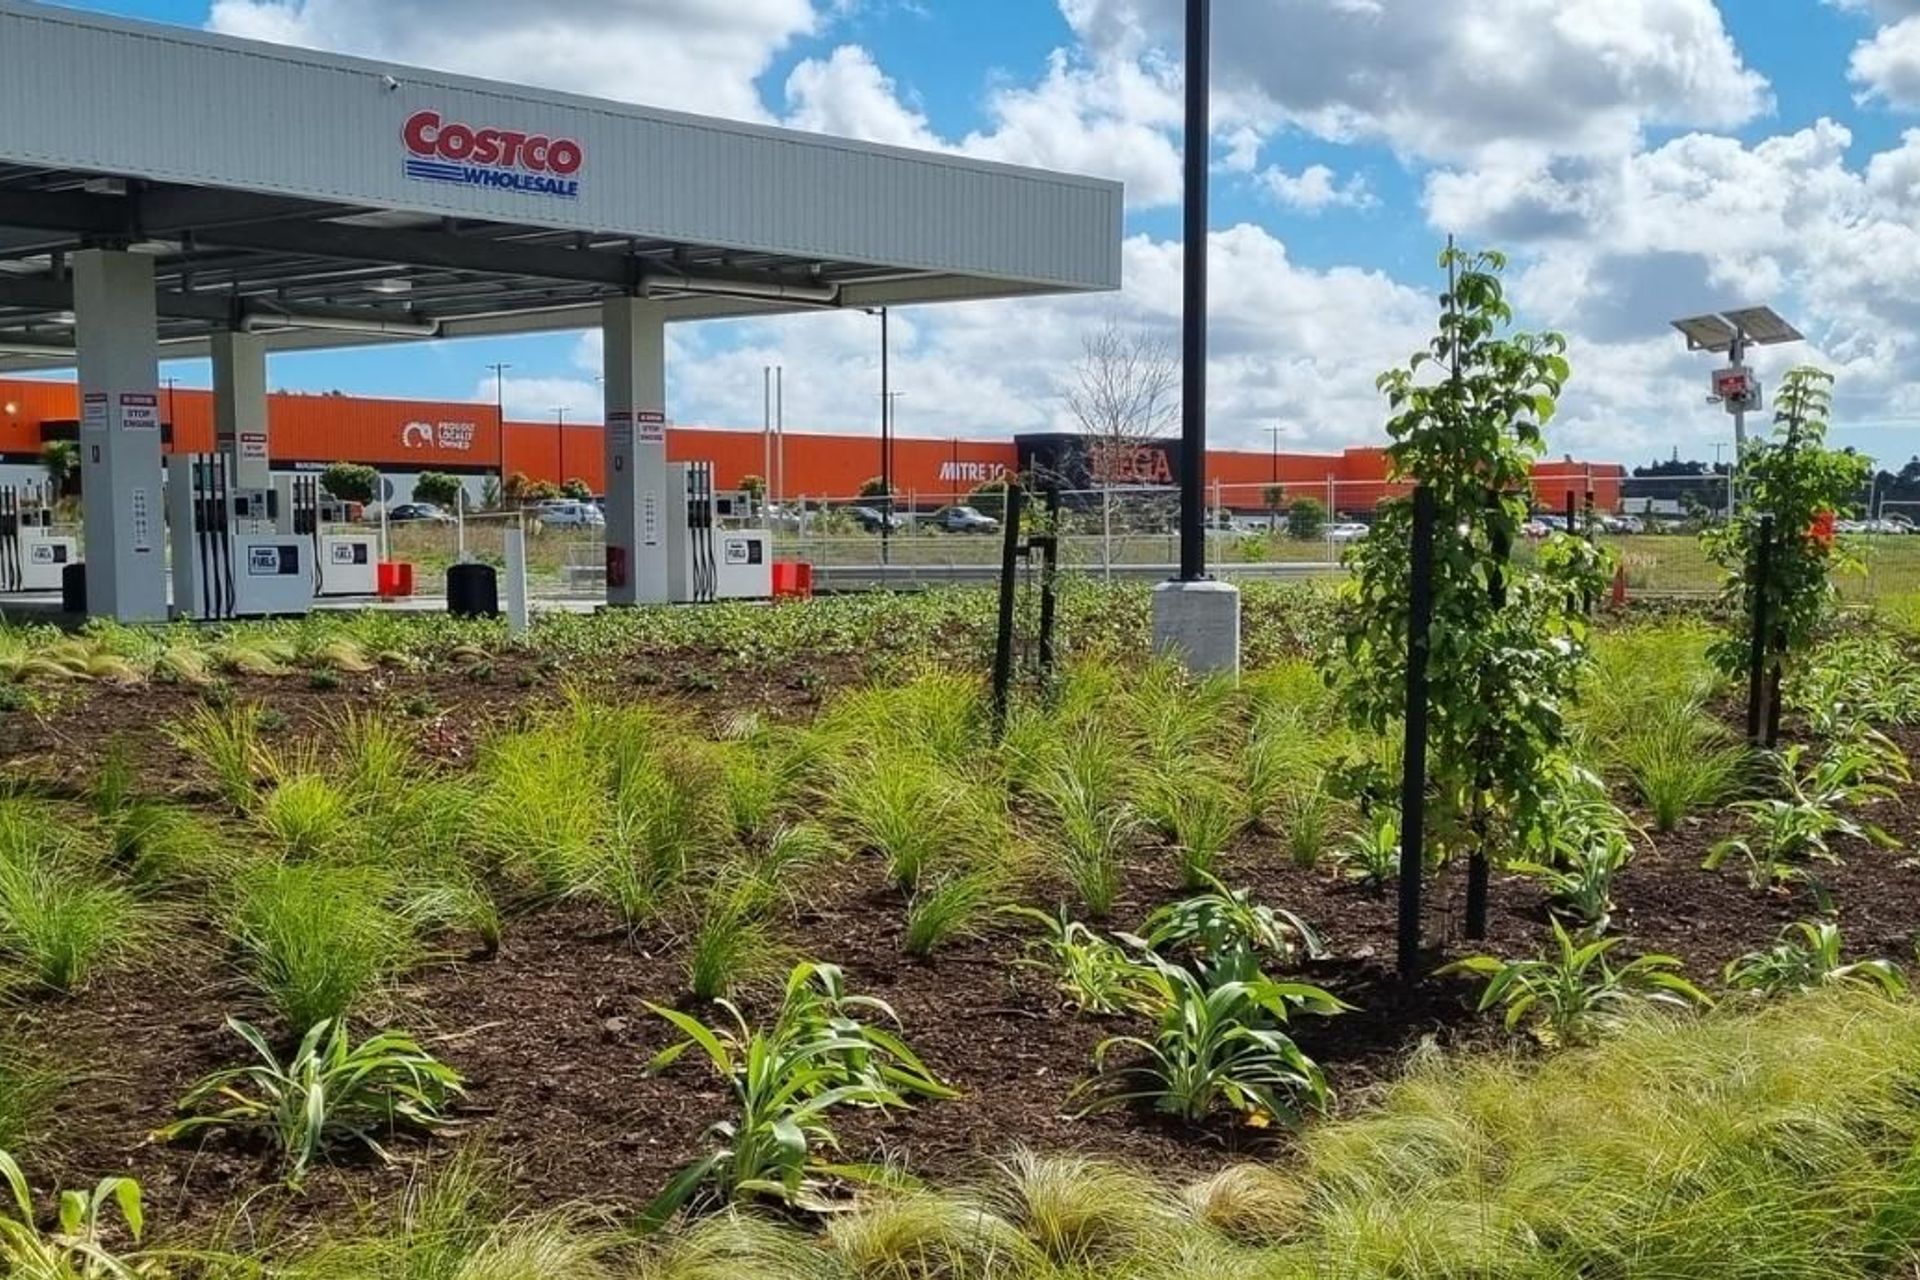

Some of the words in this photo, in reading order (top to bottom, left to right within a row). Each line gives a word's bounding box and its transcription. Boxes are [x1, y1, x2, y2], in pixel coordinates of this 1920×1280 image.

[403, 110, 582, 174] COSTCO
[464, 166, 578, 196] WHOLESALE
[127, 409, 150, 418] STOP
[123, 419, 156, 429] ENGINE
[439, 439, 471, 450] OWNED
[939, 461, 987, 481] MITRE
[989, 463, 1006, 481] 10
[252, 556, 277, 567] FUELS
